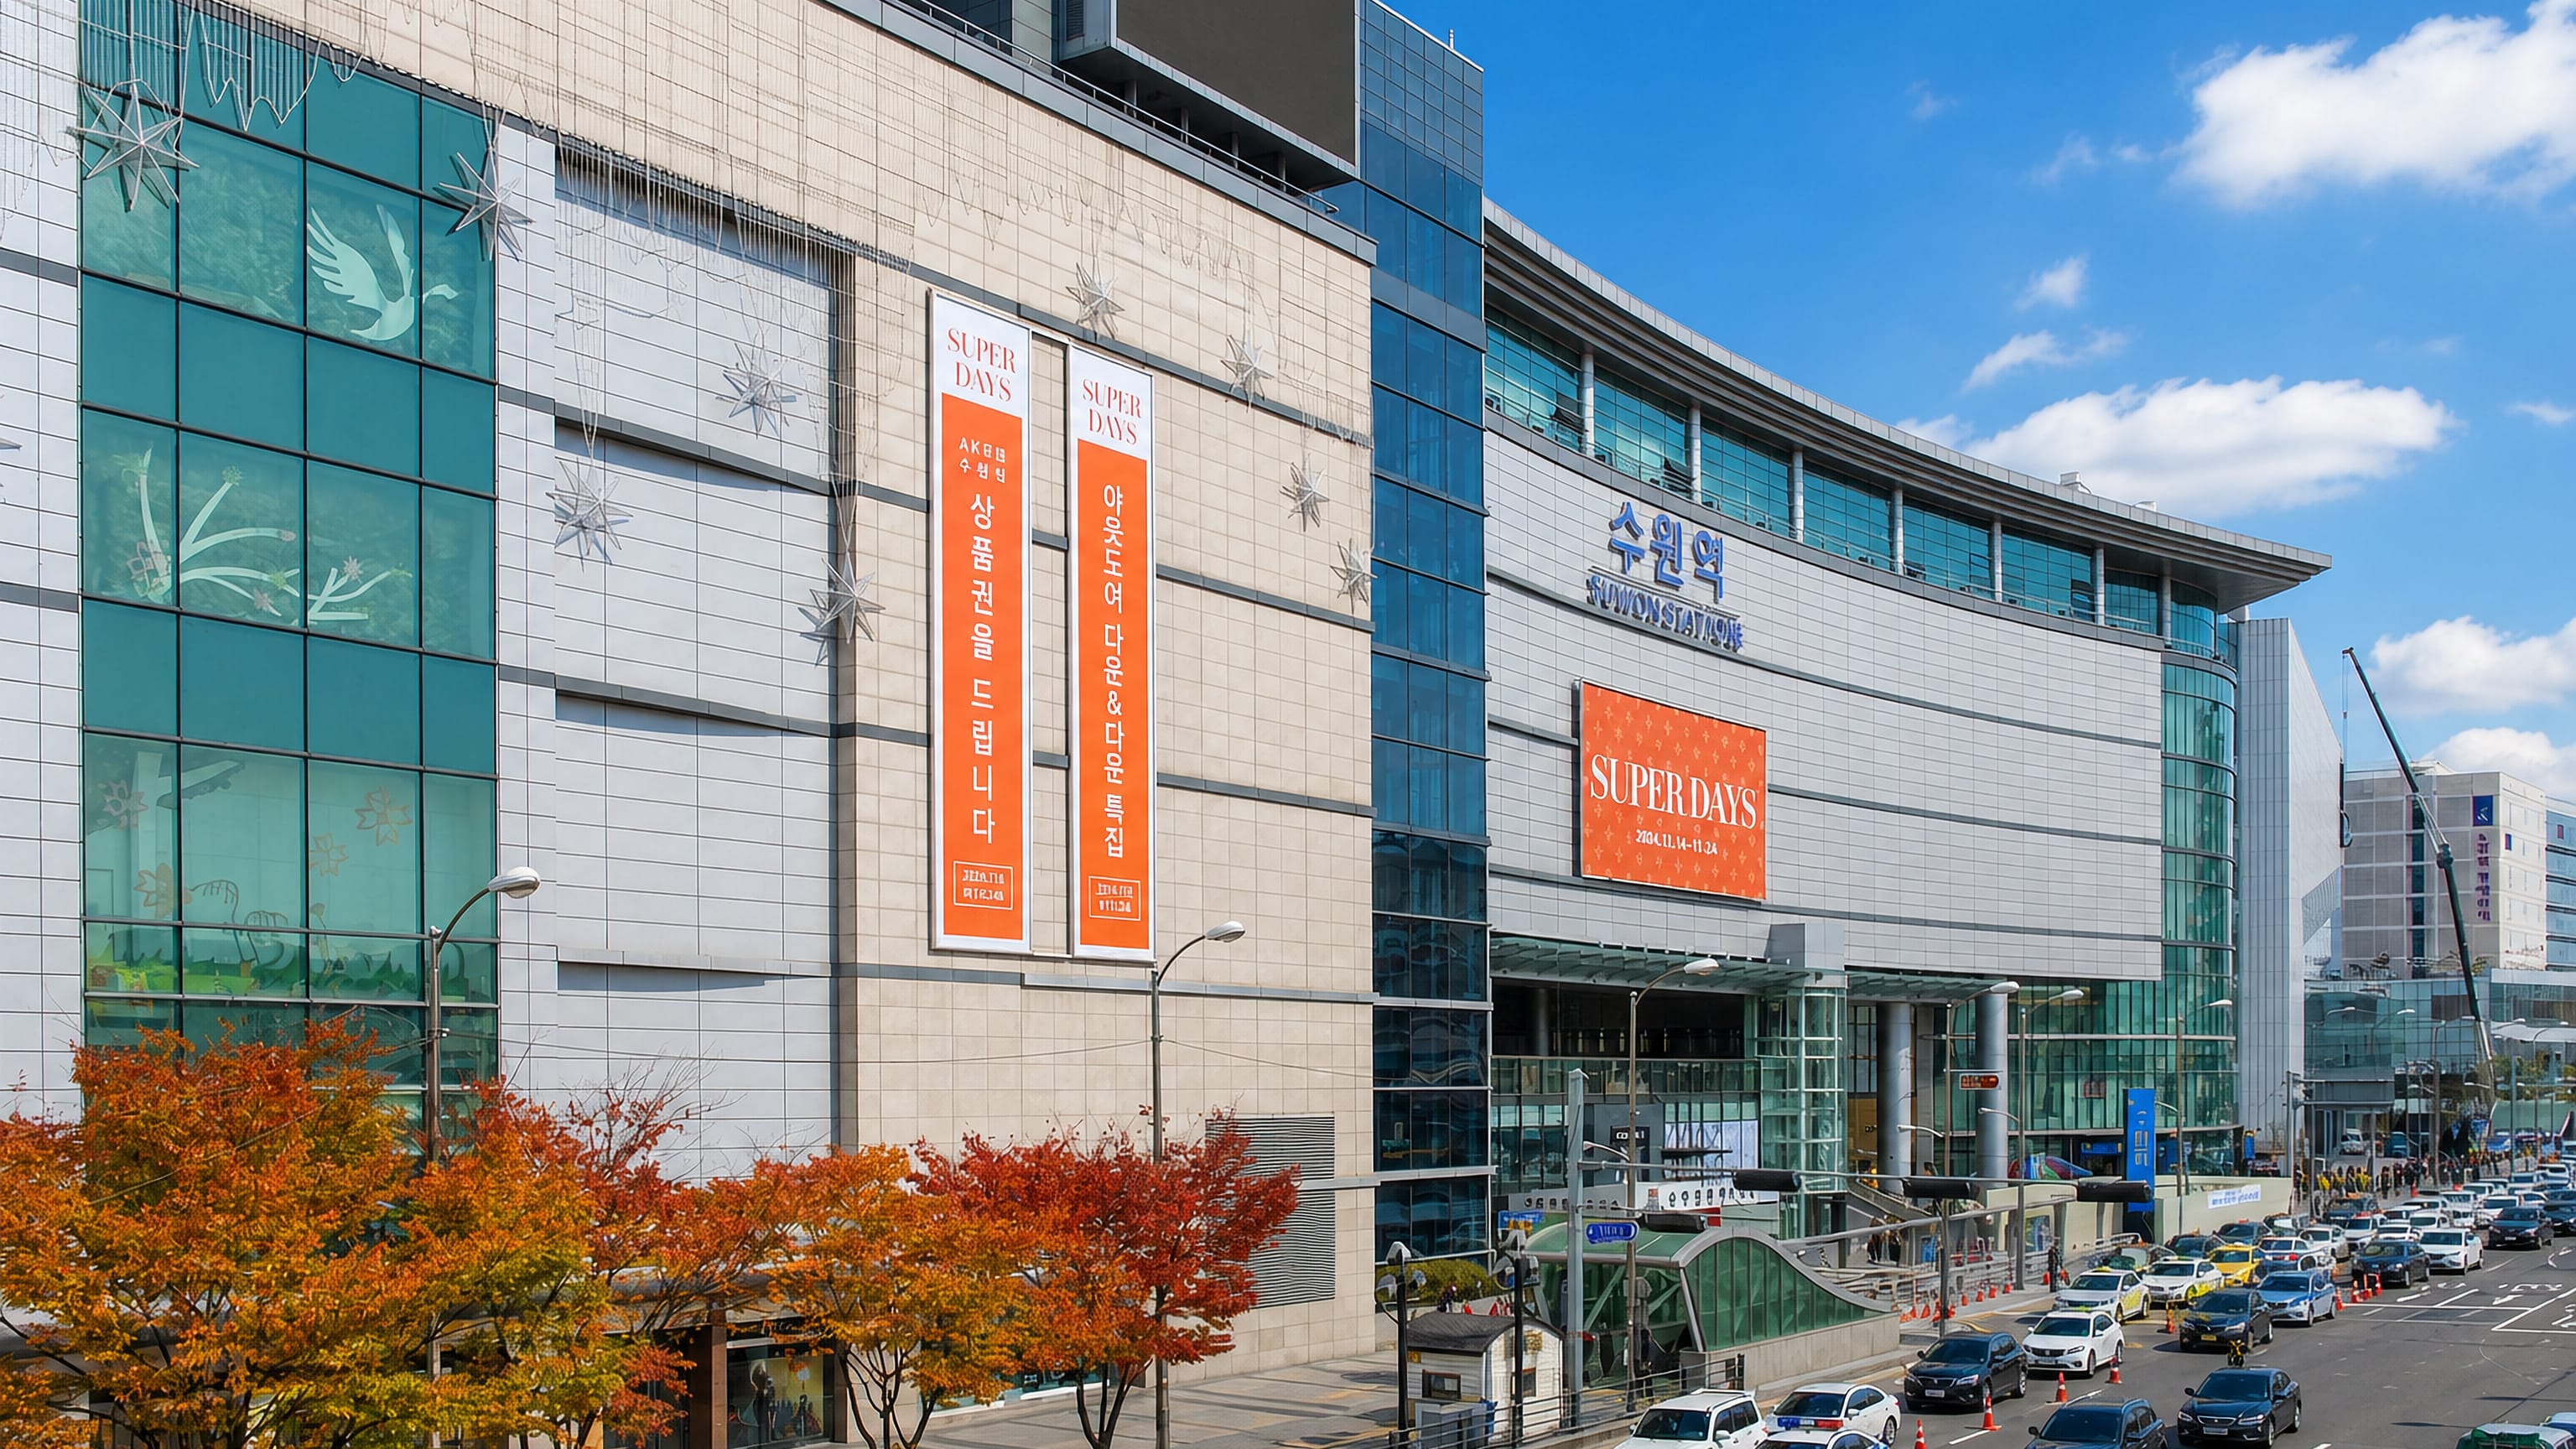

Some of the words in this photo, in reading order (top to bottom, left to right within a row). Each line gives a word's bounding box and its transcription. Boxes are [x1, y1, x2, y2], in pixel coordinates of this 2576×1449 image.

[947, 328, 1015, 374] SUPER
[956, 361, 1011, 402] DAYS
[1083, 378, 1141, 418] SUPER
[1089, 408, 1137, 445] DAYS
[970, 493, 995, 661] 상품권을
[1607, 501, 1725, 604] 수원역
[1586, 575, 1659, 626] SUWON
[1103, 622, 1124, 785] 다운&다운
[970, 678, 995, 844] 드립니다
[1590, 754, 1688, 817] SUPER
[1690, 776, 1757, 829] DAYS
[1104, 792, 1124, 860] 특집
